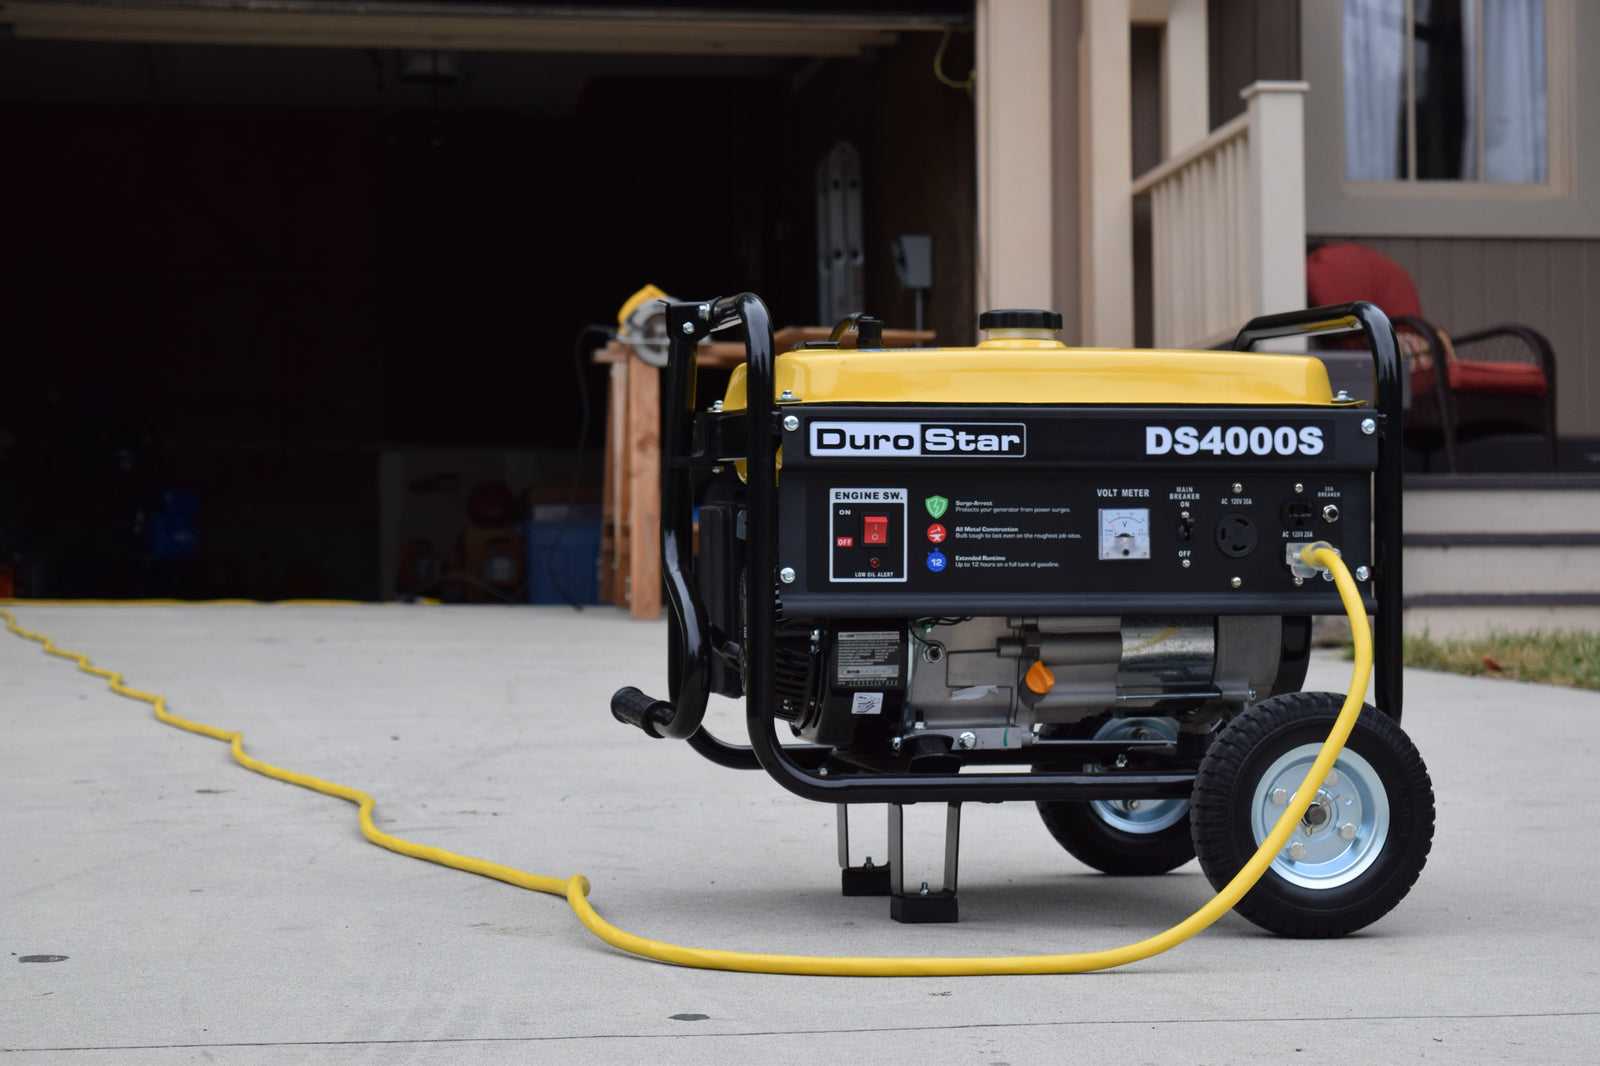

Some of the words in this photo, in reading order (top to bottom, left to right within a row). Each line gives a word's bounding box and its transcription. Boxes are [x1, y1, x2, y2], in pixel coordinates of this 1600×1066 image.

[1145, 426, 1325, 455] DS4000S
[835, 491, 879, 500] ENGINE
[882, 491, 903, 500] SW.
[1096, 488, 1118, 497] VOLT
[1122, 488, 1150, 497] METER
[930, 558, 942, 567] 12
